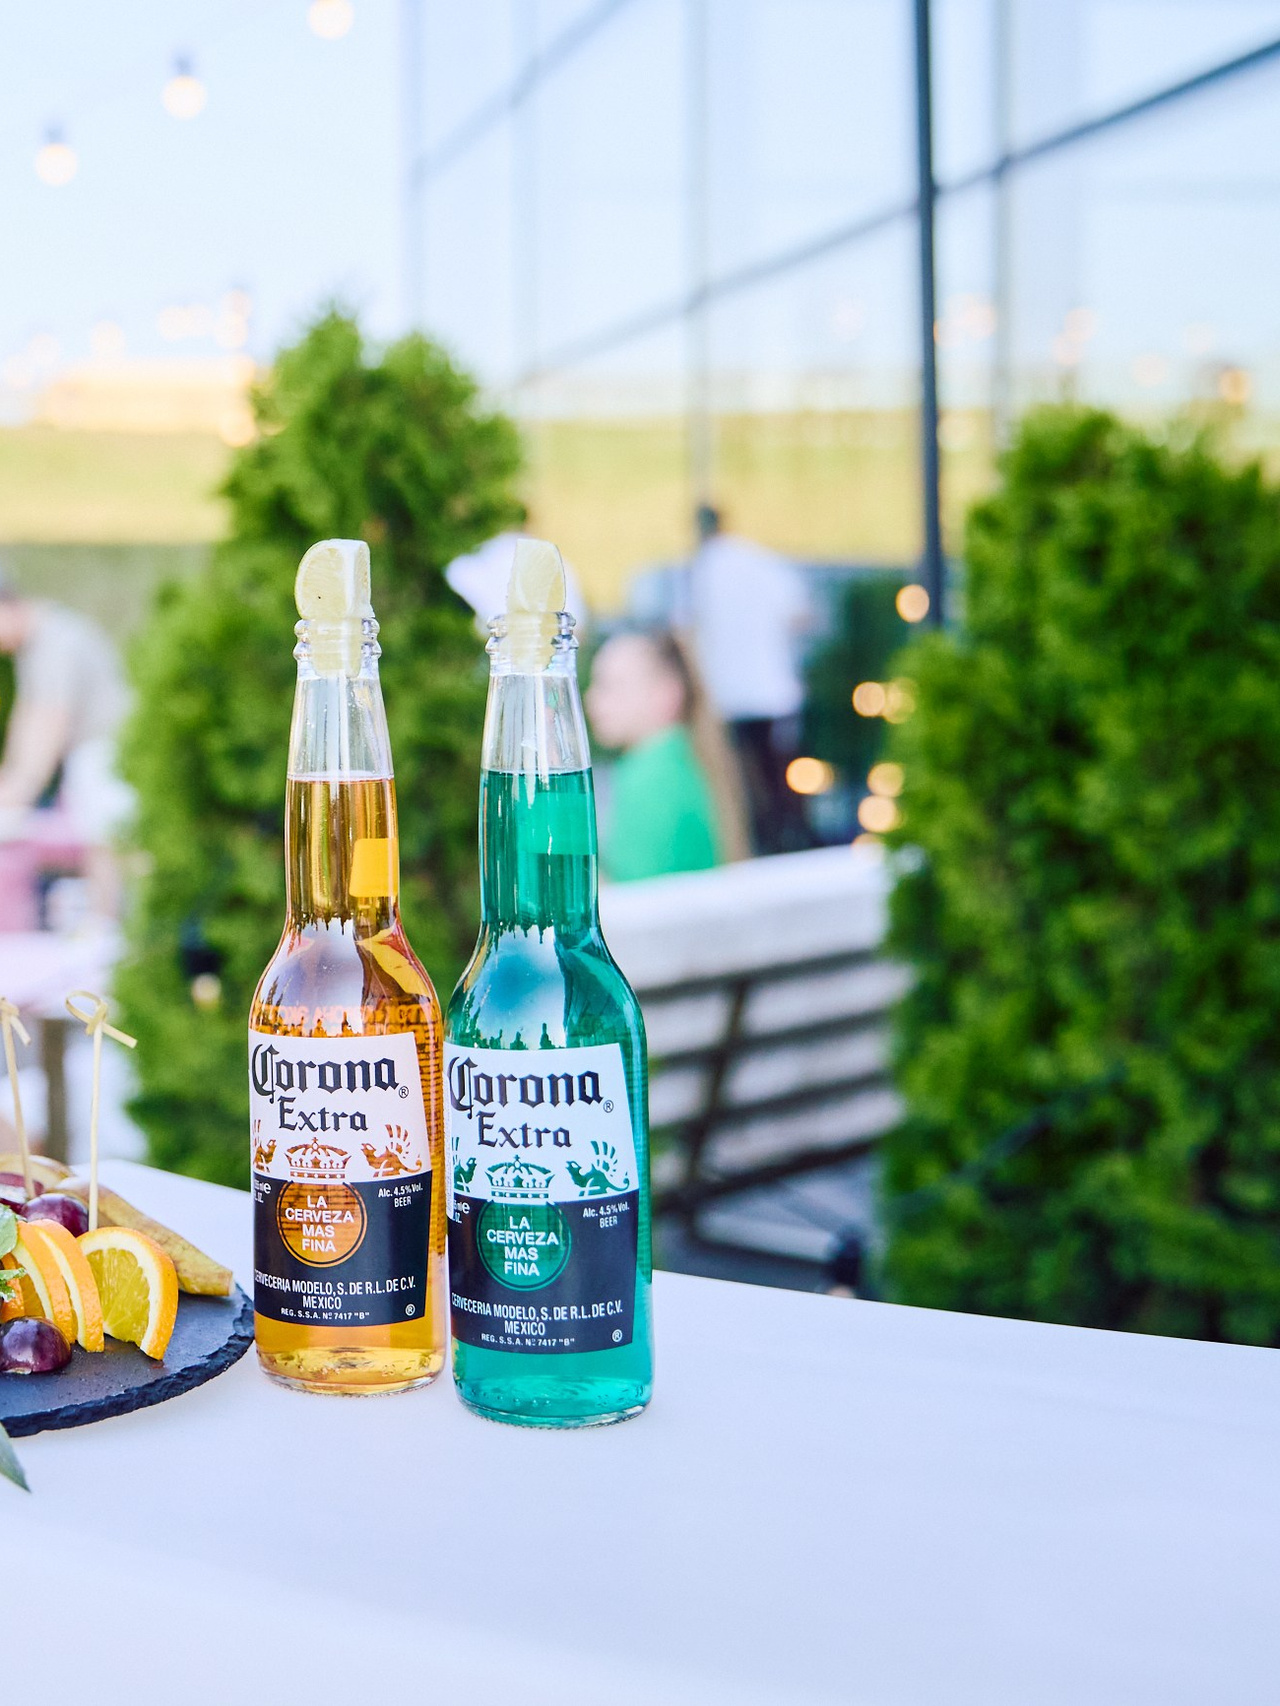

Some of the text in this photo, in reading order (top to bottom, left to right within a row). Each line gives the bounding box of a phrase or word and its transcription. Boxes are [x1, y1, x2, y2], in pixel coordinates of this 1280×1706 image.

[277, 1096, 369, 1132] Extra
[476, 1110, 572, 1149] Extra
[378, 1187, 393, 1198] Alc.
[393, 1184, 412, 1196] 4.5%
[306, 1195, 328, 1208] LA
[394, 1195, 412, 1208] BEER
[285, 1208, 355, 1223] CERVEZA
[582, 1201, 630, 1218] Alc. 4.5% Vol.
[509, 1216, 530, 1229] LA
[599, 1215, 618, 1228] BEER
[302, 1224, 335, 1237] MAS
[301, 1238, 336, 1252] FINA
[486, 1230, 559, 1246] CERVEZA
[504, 1246, 538, 1260] MAS
[504, 1261, 540, 1276] FINA
[292, 1279, 336, 1296] MODELO,
[336, 1282, 348, 1295] S.
[349, 1282, 363, 1295] DE
[365, 1280, 386, 1295] R.L.
[385, 1278, 399, 1293] DE
[400, 1275, 416, 1291] C.V.
[302, 1295, 342, 1310] MEXICO
[451, 1292, 623, 1322] CERVECERIA MODELO, S. DE R.L. DE C.V.
[280, 1307, 297, 1317] REG.
[333, 1312, 352, 1320] 7417
[504, 1320, 546, 1336] MEXICO
[481, 1333, 498, 1343] REG.
[537, 1338, 557, 1347] 7417
